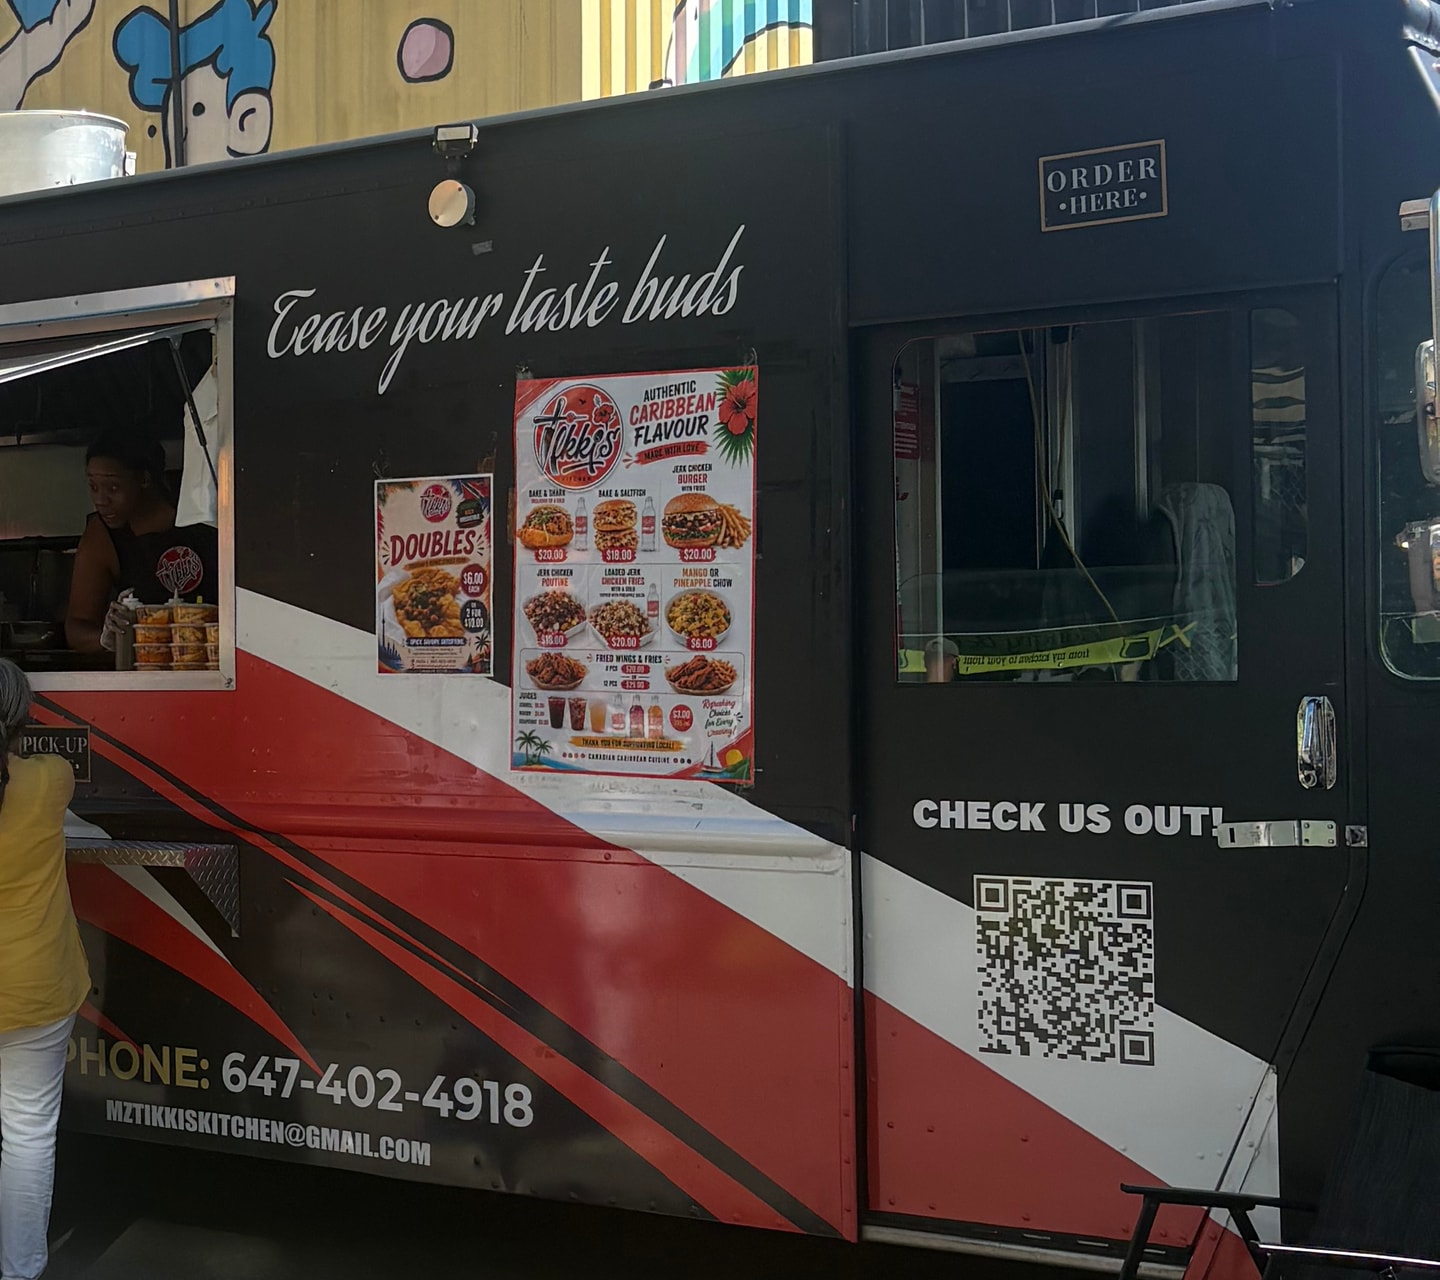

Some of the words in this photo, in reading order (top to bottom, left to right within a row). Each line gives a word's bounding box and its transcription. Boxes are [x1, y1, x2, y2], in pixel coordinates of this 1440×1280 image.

[1047, 158, 1158, 193] ORDER
[267, 288, 388, 359] Tease
[378, 292, 504, 395] your
[505, 254, 619, 336] taste
[622, 224, 746, 324] buds
[643, 380, 697, 403] AUTHENTIC
[629, 391, 717, 426] CARIBBEAN
[634, 415, 709, 447] FLAVOUR
[688, 463, 713, 473] CHICKEN
[677, 473, 708, 484] BURGER
[390, 529, 476, 567] DOUBLES
[683, 548, 712, 560] $20.00
[463, 572, 484, 585] $6.00
[682, 568, 708, 577] MANGO
[709, 568, 719, 577] OR
[541, 577, 569, 587] POUTINE
[673, 578, 712, 588] PINEAPPLE
[712, 579, 733, 588] CHOW
[611, 637, 637, 648] $20.00
[690, 638, 713, 649] $6.00
[596, 654, 614, 663] FRIED
[646, 655, 663, 664] FRIES
[22, 736, 88, 754] PICK-UP
[913, 800, 1046, 831] CHECK
[1059, 803, 1111, 834] US
[1123, 804, 1223, 836] OUT!
[221, 1051, 535, 1128] 647-402-4918
[106, 1099, 432, 1167] MZTIKKISKITCHEN@GMAIL.COM
